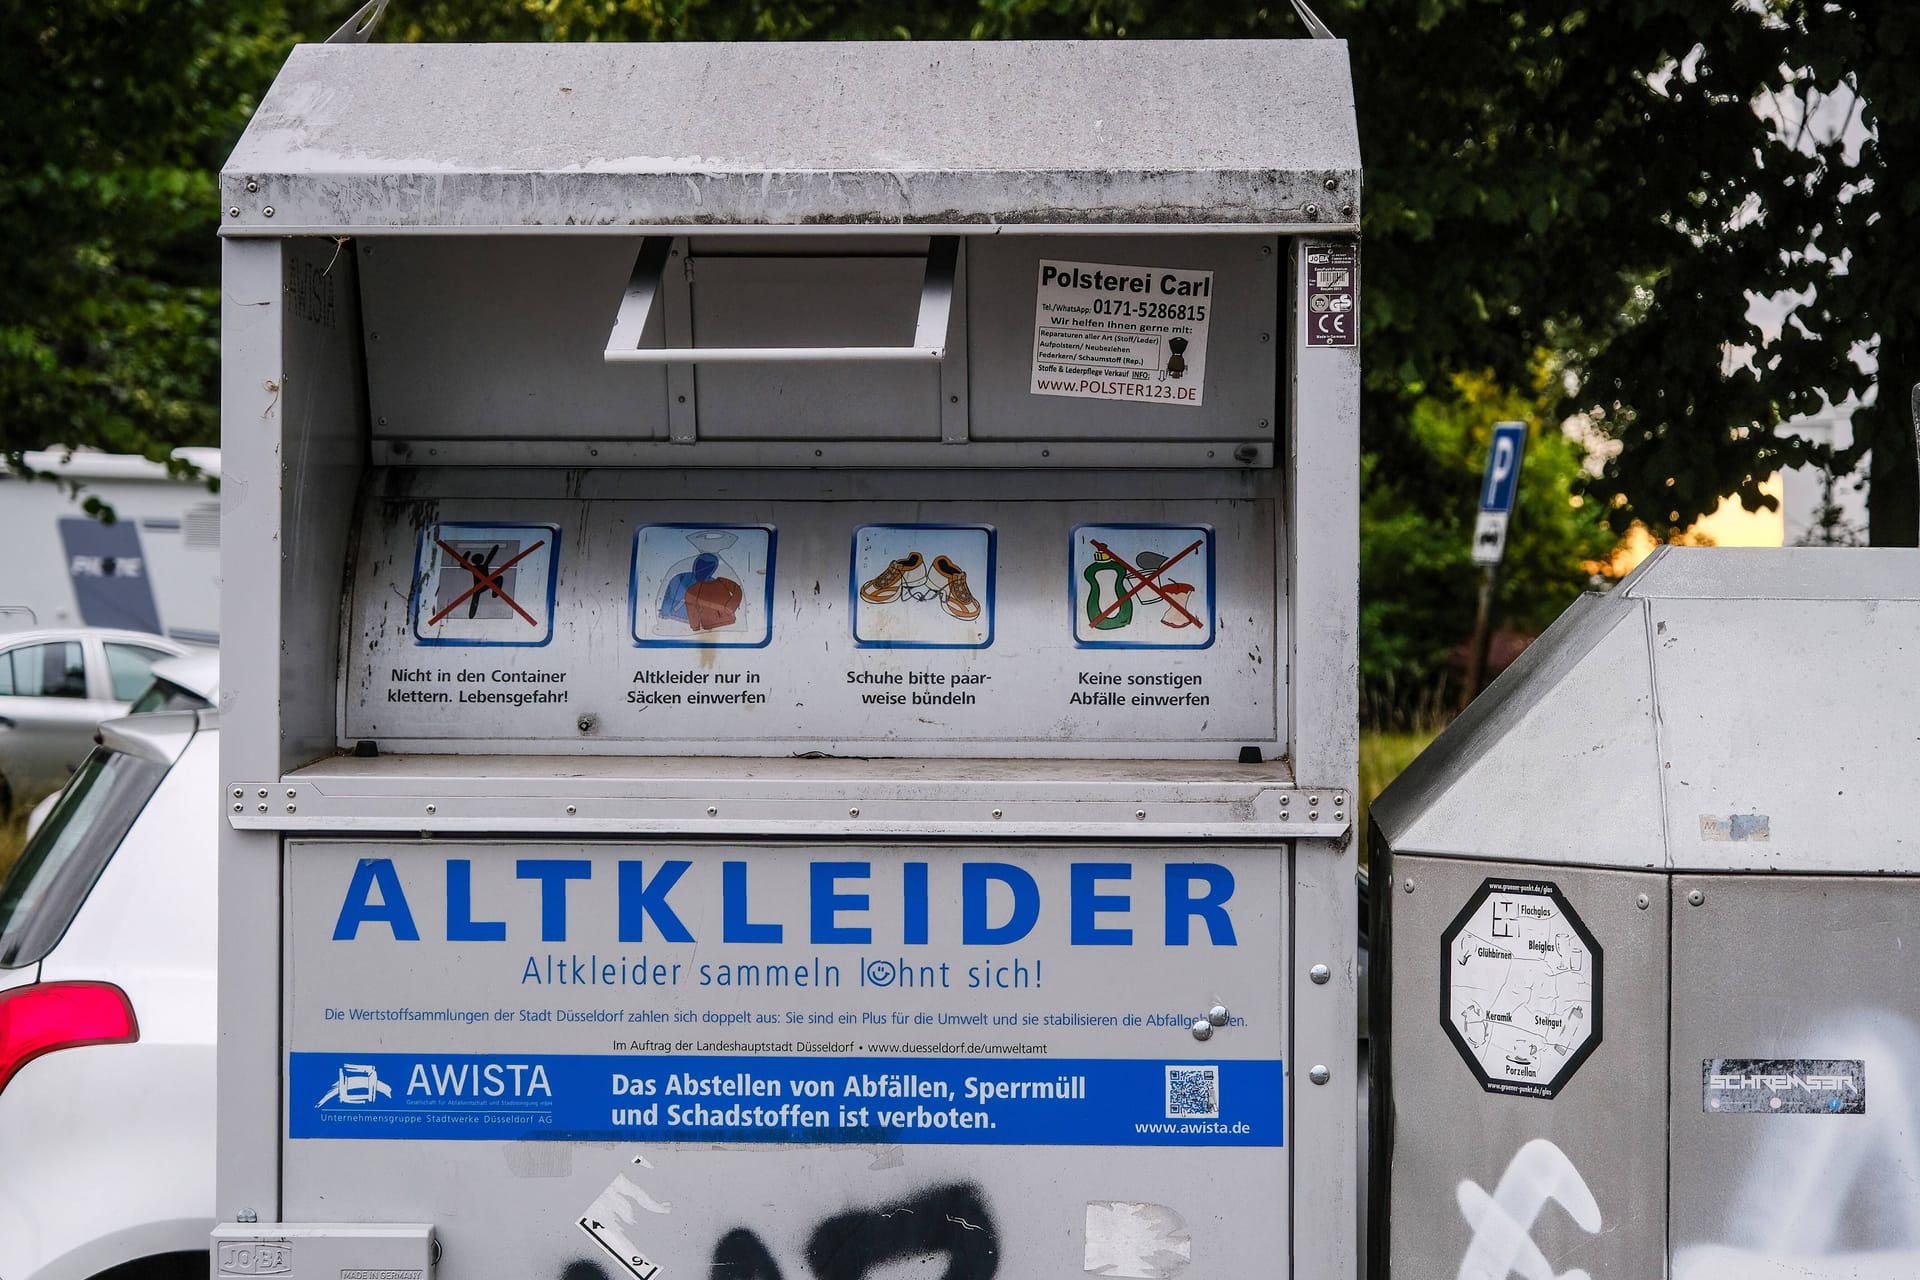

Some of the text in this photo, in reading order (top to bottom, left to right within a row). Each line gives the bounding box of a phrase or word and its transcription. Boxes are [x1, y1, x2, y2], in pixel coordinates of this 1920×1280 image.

[1042, 265, 1210, 297] Polsterei Carl
[1042, 299, 1206, 321] Tel./WhatsApp: 0171-5286815
[1051, 317, 1193, 334] Wir helfen Ihnen gerne mit:
[1041, 330, 1083, 341] Reparaturen
[1114, 336, 1159, 345] (Stoff/Leder)
[1040, 341, 1131, 353] Aufpolstern/ Neubeziehen
[1039, 352, 1144, 366] Federkern/ Schaumstoff (Rep.)
[1038, 364, 1057, 372] Stoffe
[1065, 366, 1103, 377] Lederpflege
[1104, 369, 1129, 378] Verkauf
[1132, 371, 1150, 379] INFO:
[1037, 379, 1197, 400] www.POLSTER123.DE
[1487, 435, 1515, 506] P
[392, 669, 566, 682] Nicht in den Container
[633, 670, 760, 683] Altkleider nur in
[847, 671, 991, 687] Schuhe bitte paar-
[1079, 672, 1201, 689] Keine sonstigen
[388, 689, 567, 707] klettern. Lebensgefahr!
[627, 691, 765, 704] Säcken einwerfen
[862, 692, 975, 704] weise bündeln
[1070, 692, 1209, 705] Abfälle einwerfen
[332, 854, 1242, 946] ALTKLEIDER
[1521, 904, 1551, 917] Flachglas
[1528, 939, 1555, 952] Bleiglas
[1477, 947, 1512, 960] Glühbirnen
[522, 955, 681, 985] Altkleider
[700, 957, 839, 987] sammeln
[969, 958, 1040, 988] sich!
[325, 1008, 344, 1020] Die
[349, 1008, 489, 1024] Wertstoffsammlungen
[494, 1009, 515, 1021] der
[520, 1009, 552, 1021] Stadt
[557, 1010, 624, 1022] Düsseldorf
[628, 1010, 669, 1022] zahlen
[674, 1010, 697, 1022] sich
[703, 1010, 751, 1026] doppelt
[756, 1014, 780, 1023] aus:
[786, 1012, 803, 1023] Sie
[809, 1012, 833, 1024] sind
[839, 1012, 856, 1024] ein
[863, 1012, 886, 1024] Plus
[891, 1012, 909, 1024] für
[914, 1012, 933, 1024] die
[938, 1013, 988, 1025] Umwelt
[993, 1013, 1017, 1025] und
[1023, 1016, 1039, 1025] sie
[1044, 1013, 1117, 1026] stabilisieren
[1123, 1014, 1141, 1026] die
[1486, 1010, 1512, 1023] Keramik
[1535, 1016, 1562, 1029] Steingut
[614, 1040, 626, 1050] Im
[629, 1040, 672, 1054] Auftrag
[675, 1040, 693, 1051] der
[697, 1041, 792, 1054] Landeshauptstadt
[797, 1041, 854, 1052] Düsseldorf
[868, 1042, 1047, 1054] www.duesseldorf.de/umweltamt
[1505, 1065, 1537, 1078] Porzellan
[407, 1064, 552, 1096] AWISTA
[613, 1073, 1085, 1103] Das Abstellen von Abfällen, Sperrmüll
[321, 1113, 552, 1124] Unternehmensgruppe Stadtwerke Düsseldorf AG
[612, 1103, 995, 1128] und Schadstoffen ist verboten.
[1135, 1121, 1250, 1133] www.awista.de
